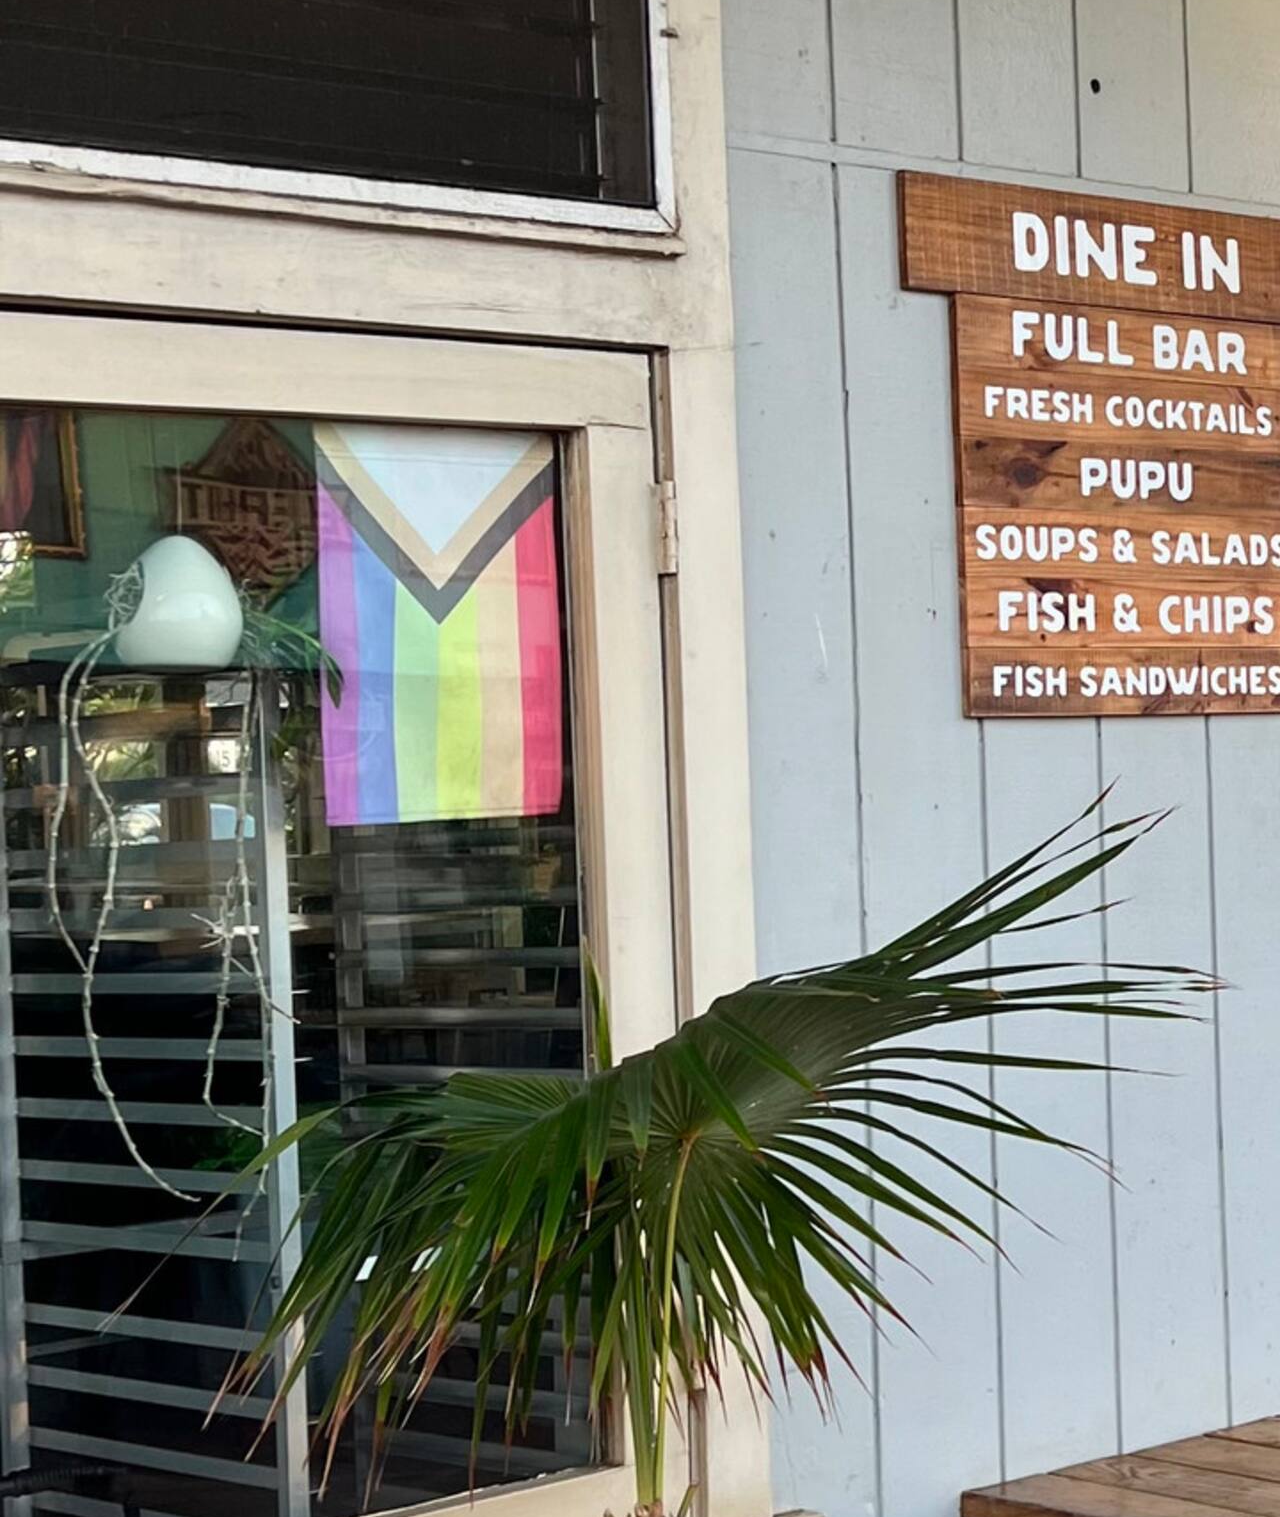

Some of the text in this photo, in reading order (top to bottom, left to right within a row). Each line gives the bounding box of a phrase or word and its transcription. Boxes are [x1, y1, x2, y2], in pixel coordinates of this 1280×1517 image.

[1011, 210, 1242, 295] DINE IN
[1010, 309, 1249, 376] FULL BAR
[983, 385, 1274, 438] FRESH COCKTAILS
[1079, 456, 1194, 503] PUPU
[974, 522, 1099, 565] SOUPS
[1111, 528, 1139, 565] &
[997, 589, 1276, 637] FISH & CHIPS
[992, 664, 1068, 699] FISH
